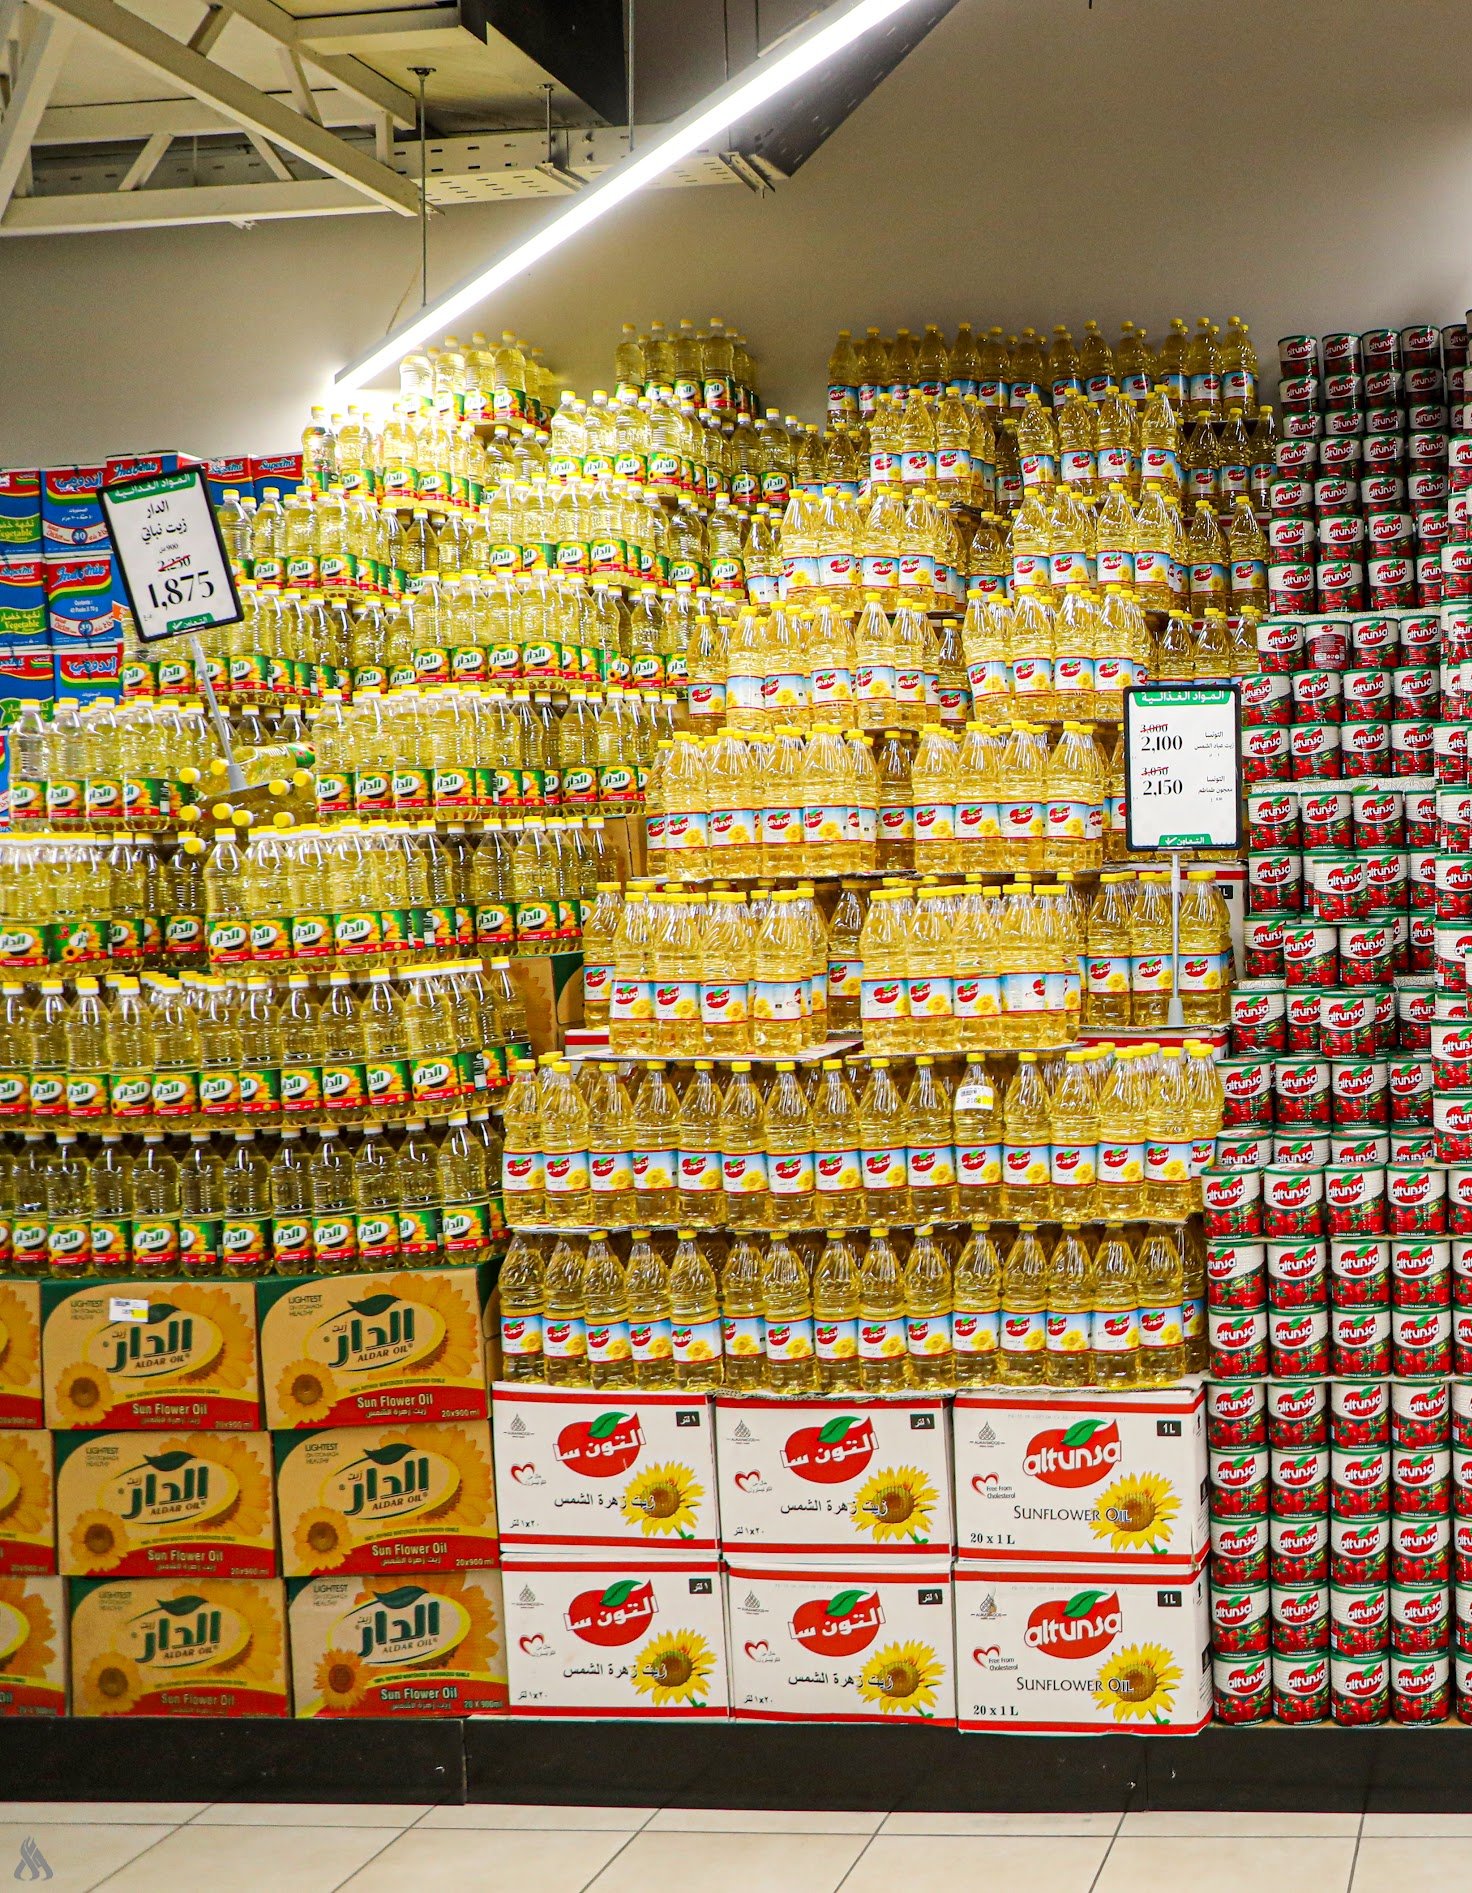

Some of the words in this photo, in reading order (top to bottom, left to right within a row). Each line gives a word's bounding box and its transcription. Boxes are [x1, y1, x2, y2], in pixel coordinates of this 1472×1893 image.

[147, 500, 169, 519] الدار
[166, 519, 187, 534] زيت
[141, 526, 163, 545] نباتي
[148, 571, 214, 610] 1,875
[1192, 691, 1224, 703] المواد
[1141, 735, 1183, 752] 2,100
[1142, 780, 1183, 796] 2,150
[1396, 1251, 1435, 1271] altunsa
[328, 1308, 415, 1369] الدار
[1275, 1321, 1314, 1341] altunsa
[106, 1319, 193, 1373] الدار
[135, 1358, 166, 1369] ALDAR
[169, 1356, 184, 1364] OIL
[357, 1350, 389, 1362] ALDAR
[393, 1348, 407, 1357] OIL
[132, 1404, 151, 1414] Sun
[155, 1403, 188, 1414] Flower
[192, 1403, 207, 1414] Oil
[357, 1397, 377, 1409] Sun
[380, 1395, 415, 1407] Flower
[419, 1393, 433, 1405] Oil
[1163, 1424, 1176, 1434] 1L
[1023, 1441, 1122, 1476] altunsa
[121, 1466, 208, 1519] الدار
[343, 1457, 429, 1515] الدار
[554, 1493, 594, 1507] الشمس
[1014, 1505, 1101, 1521] SUNFLOWER
[970, 1533, 983, 1544] 20
[987, 1536, 993, 1544] x
[997, 1534, 1003, 1544] 1
[1007, 1535, 1015, 1545] L
[1164, 1594, 1176, 1604] 1L
[1024, 1611, 1123, 1648] altunsa
[382, 1643, 414, 1654] ALDAR
[417, 1640, 432, 1648] OIL
[1016, 1677, 1103, 1692] SUNFLOWER
[381, 1688, 400, 1699] Sun
[404, 1688, 439, 1699] Flower
[442, 1687, 458, 1698] Oil
